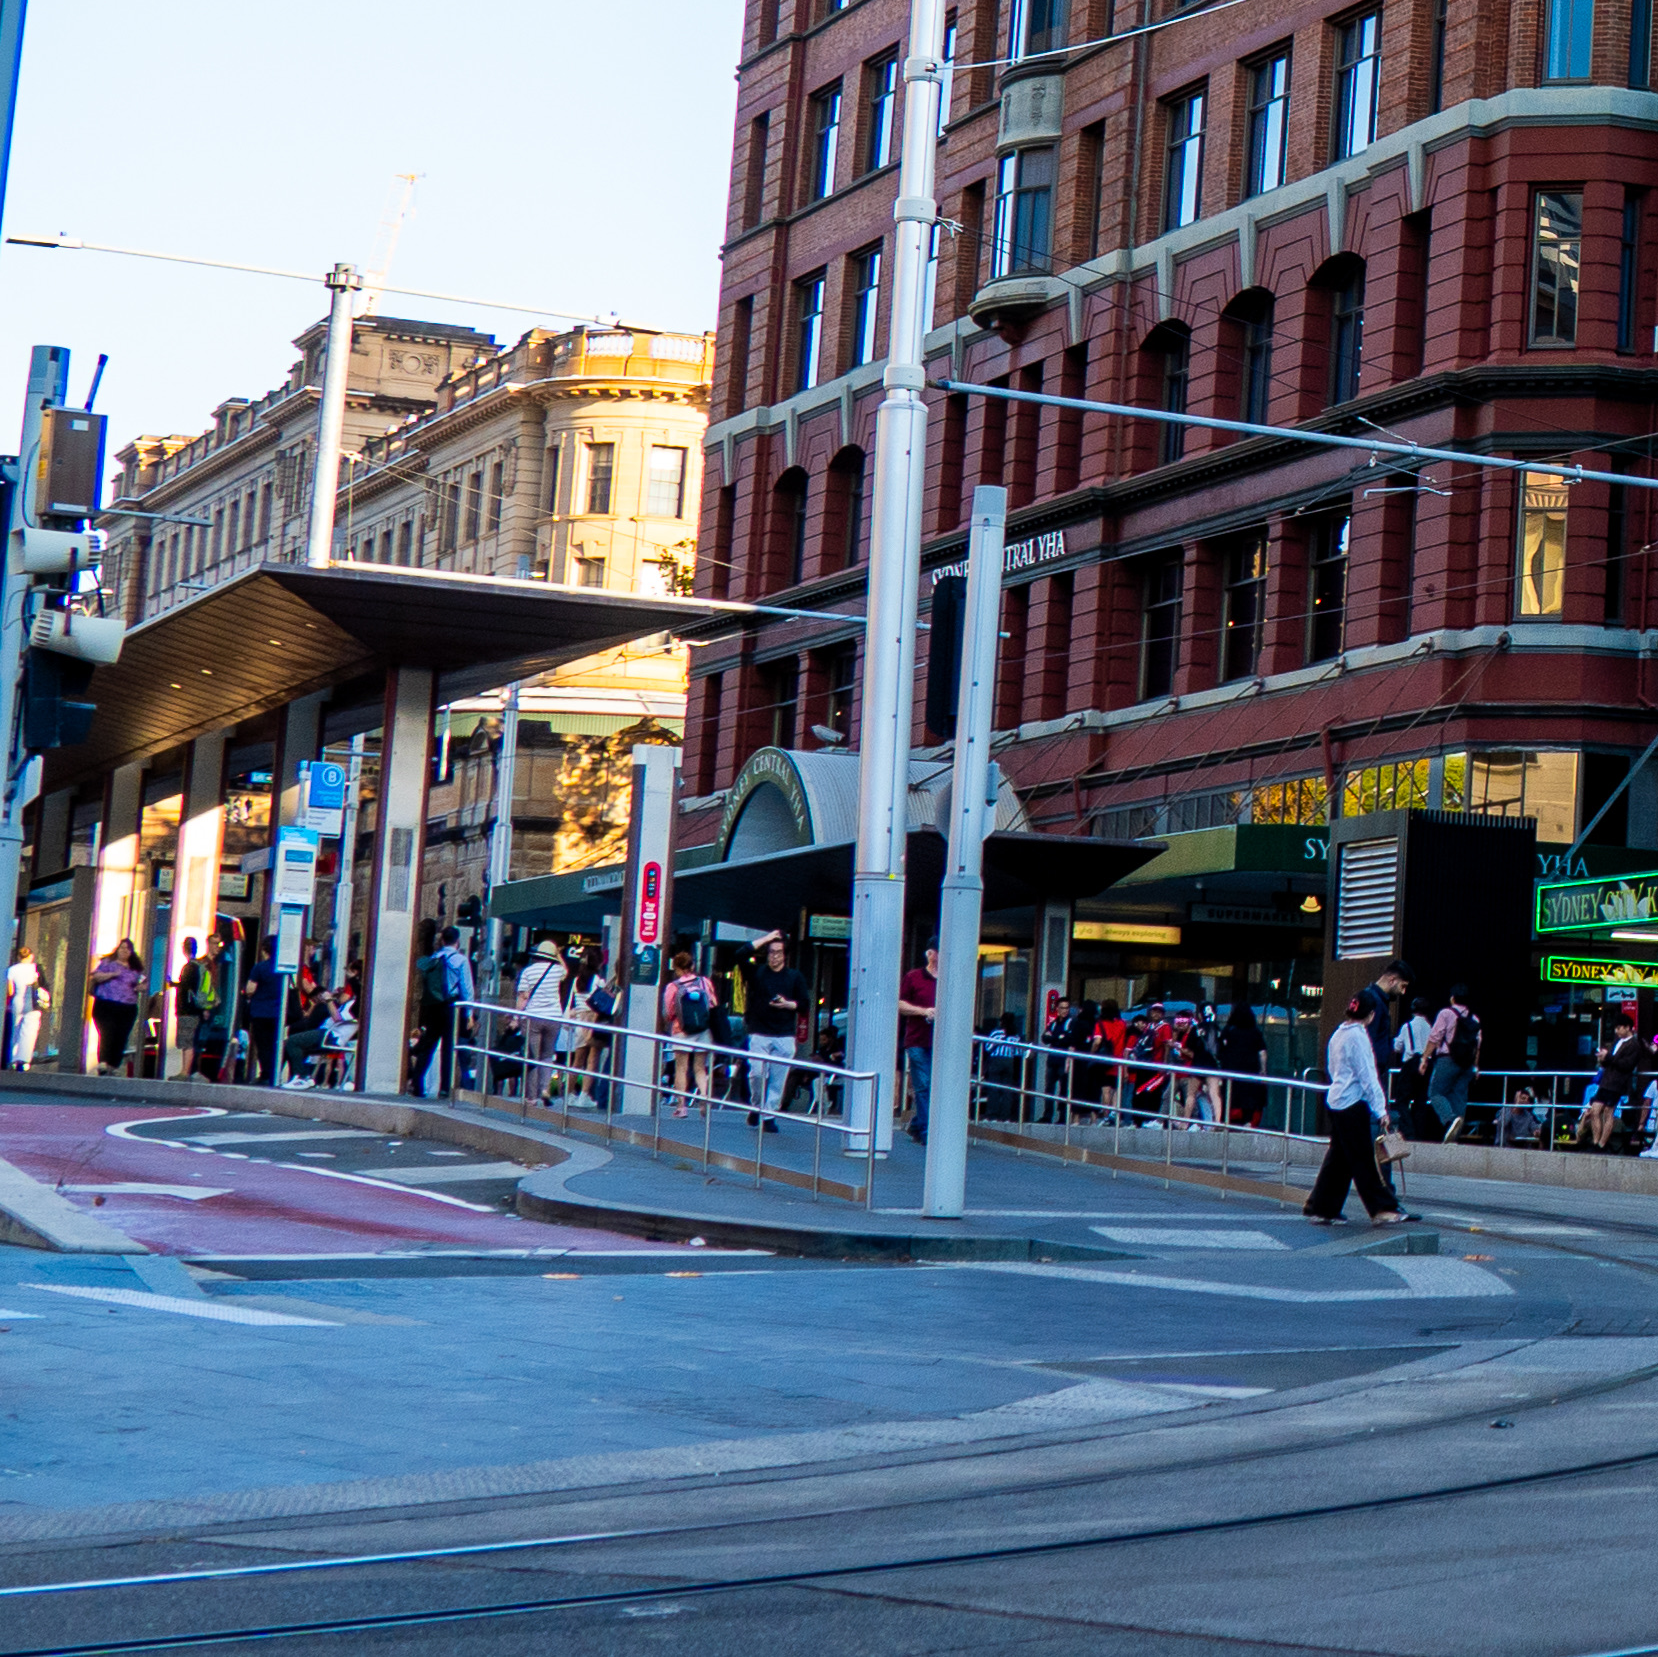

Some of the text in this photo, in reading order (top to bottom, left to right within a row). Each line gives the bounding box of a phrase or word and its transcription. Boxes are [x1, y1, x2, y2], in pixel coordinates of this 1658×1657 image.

[1038, 530, 1065, 561] YHA
[753, 753, 790, 785] CENTRAL
[790, 788, 805, 832] YHA
[1538, 854, 1589, 877] YHA
[1208, 909, 1304, 925] SUPERMARKET
[1542, 886, 1603, 925] SYDNEY
[1605, 882, 1644, 920] CITY
[1552, 962, 1612, 980] SYDNEY
